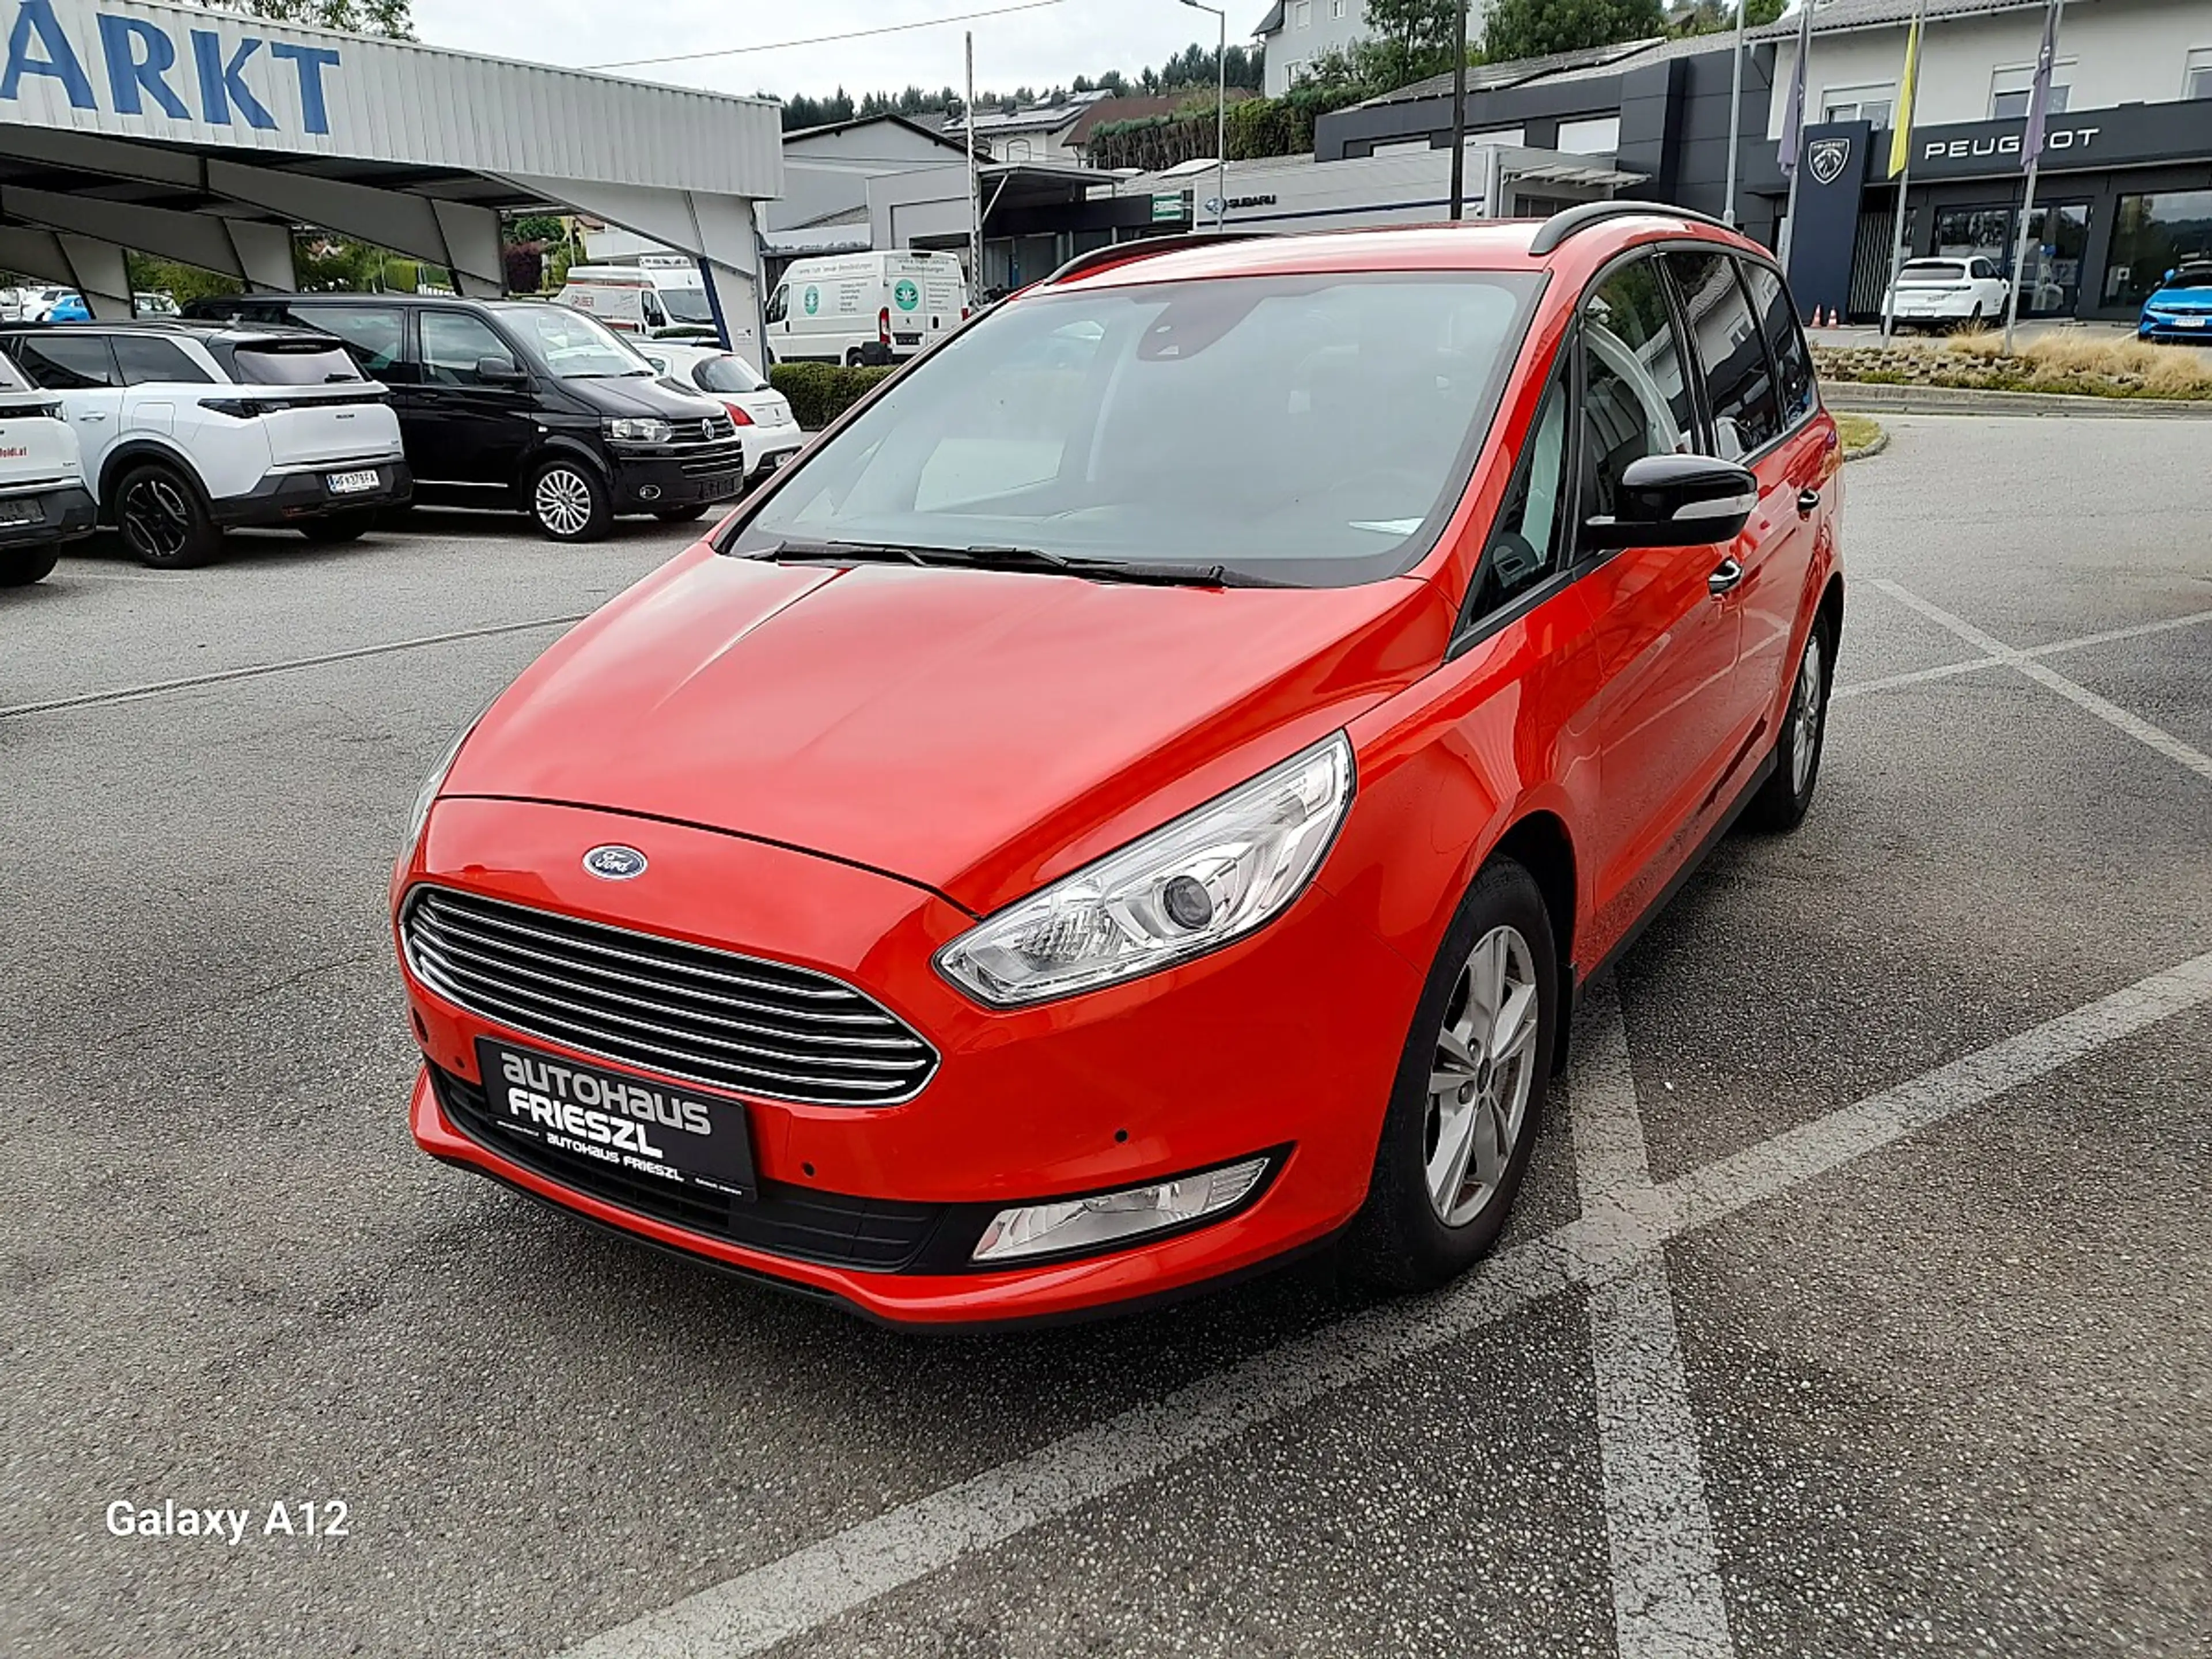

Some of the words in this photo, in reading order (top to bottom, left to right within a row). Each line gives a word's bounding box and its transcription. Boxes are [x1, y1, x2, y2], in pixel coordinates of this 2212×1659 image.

[0, 0, 340, 135] ARKT
[1925, 128, 2100, 160] PEUGOT
[1228, 195, 1276, 208] SUBARU
[594, 851, 634, 873] Ford
[508, 1088, 664, 1157] FRIESZL
